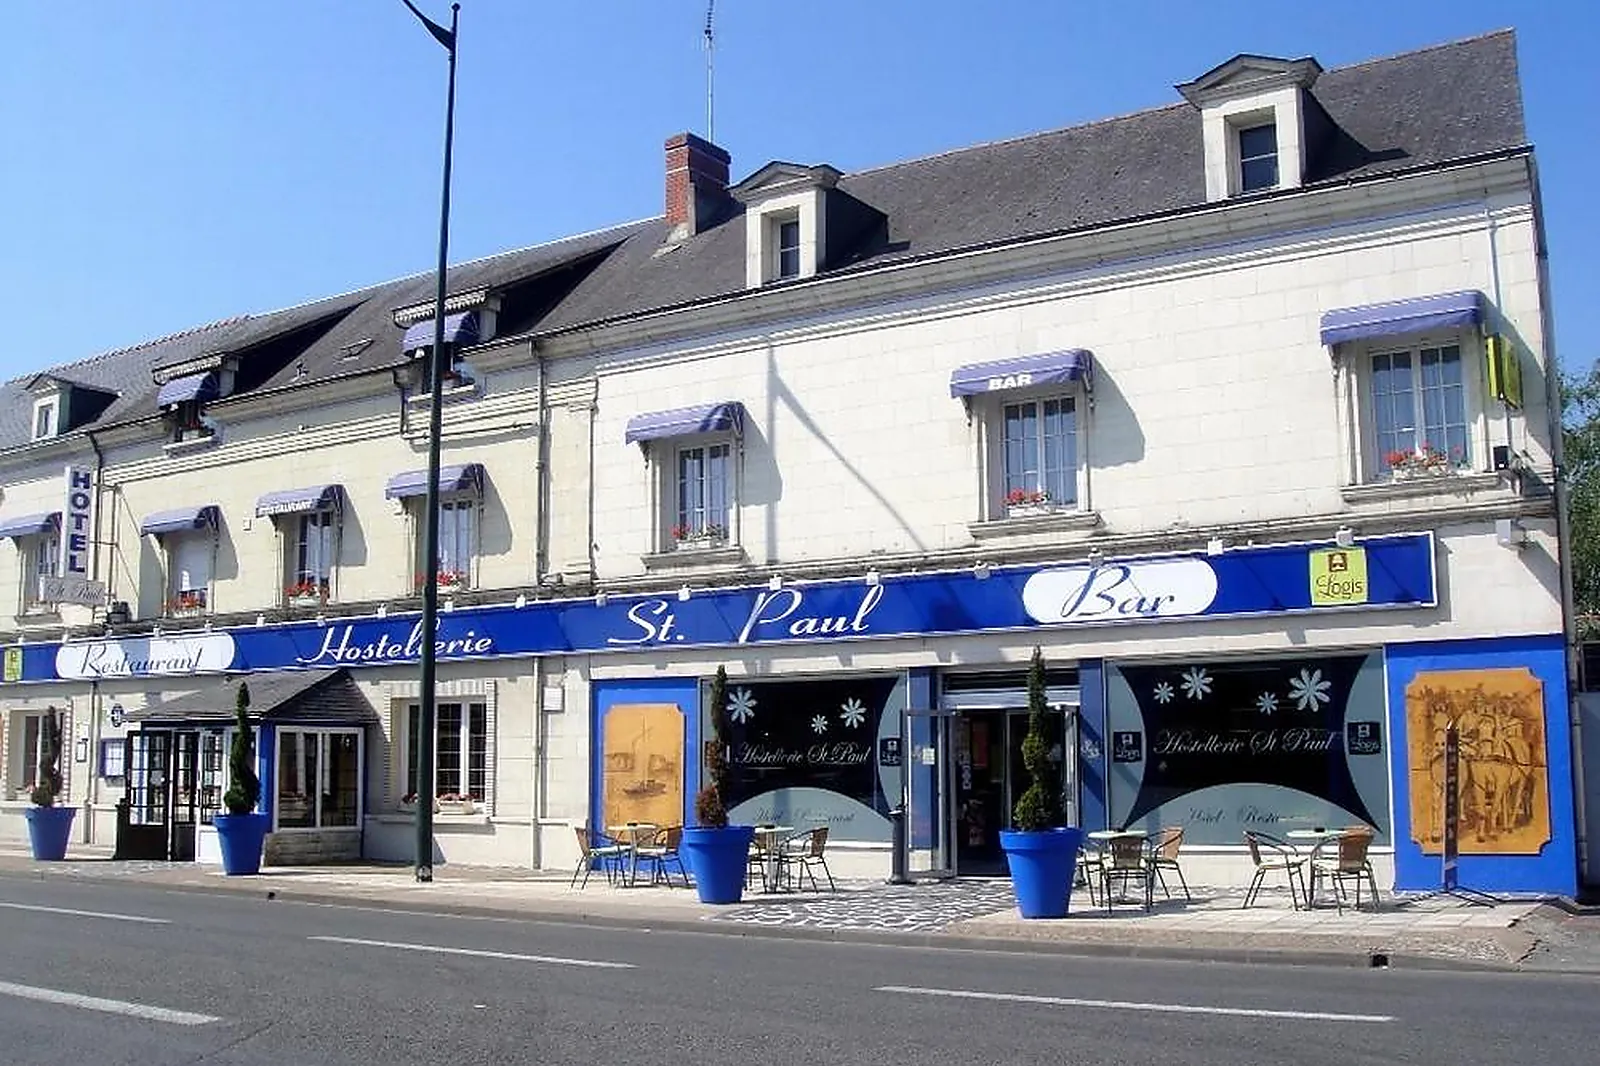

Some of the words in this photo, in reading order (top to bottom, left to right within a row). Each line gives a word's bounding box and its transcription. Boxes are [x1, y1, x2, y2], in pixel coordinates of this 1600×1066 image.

[987, 374, 1032, 391] BAR
[69, 471, 90, 573] HOTEL
[1060, 564, 1175, 617] Bar
[1316, 573, 1364, 600] Logis
[607, 600, 685, 643] St.
[738, 585, 884, 645] Paul
[81, 643, 203, 675] Restaurant
[1153, 728, 1246, 754] Hostellerie
[1281, 727, 1335, 753] Paul
